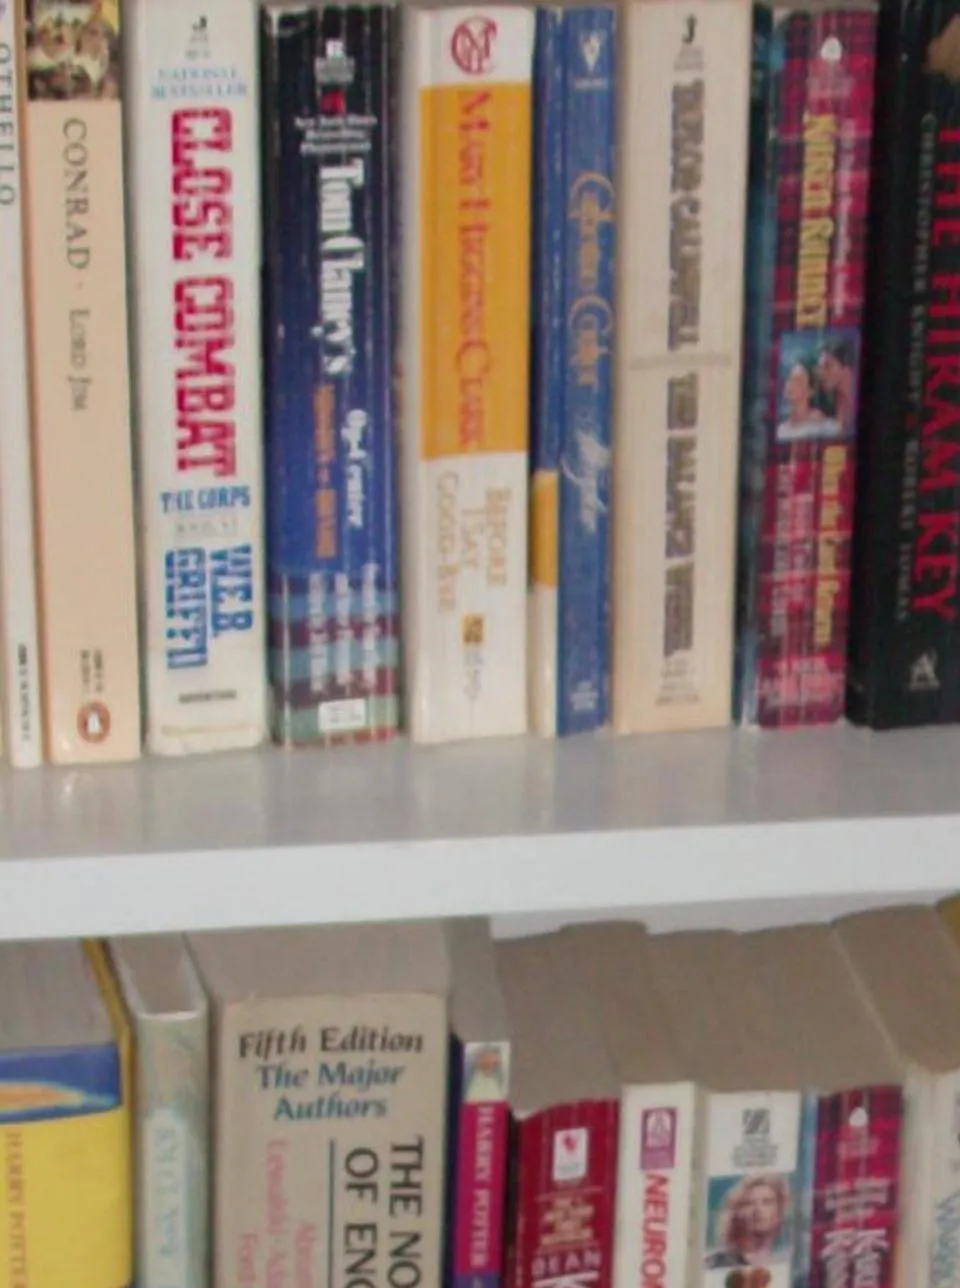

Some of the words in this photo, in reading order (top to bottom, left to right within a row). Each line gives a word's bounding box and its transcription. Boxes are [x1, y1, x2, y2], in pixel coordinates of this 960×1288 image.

[62, 117, 92, 270] CONRAD
[170, 106, 233, 262] CLOSE
[318, 158, 364, 231] Tom
[311, 235, 367, 374] Clancy's
[173, 274, 238, 478] COMBAT
[194, 483, 251, 511] CORPS
[238, 1023, 308, 1061] Fifth
[318, 1024, 425, 1056] Edition
[255, 1062, 310, 1091] The
[317, 1058, 408, 1093] Major
[272, 1090, 389, 1122] Authors
[474, 1104, 497, 1183] HARRY
[5, 1130, 25, 1207] HARRY
[342, 1148, 380, 1203] OF
[385, 1136, 425, 1216] THE
[469, 1187, 493, 1269] POTTER
